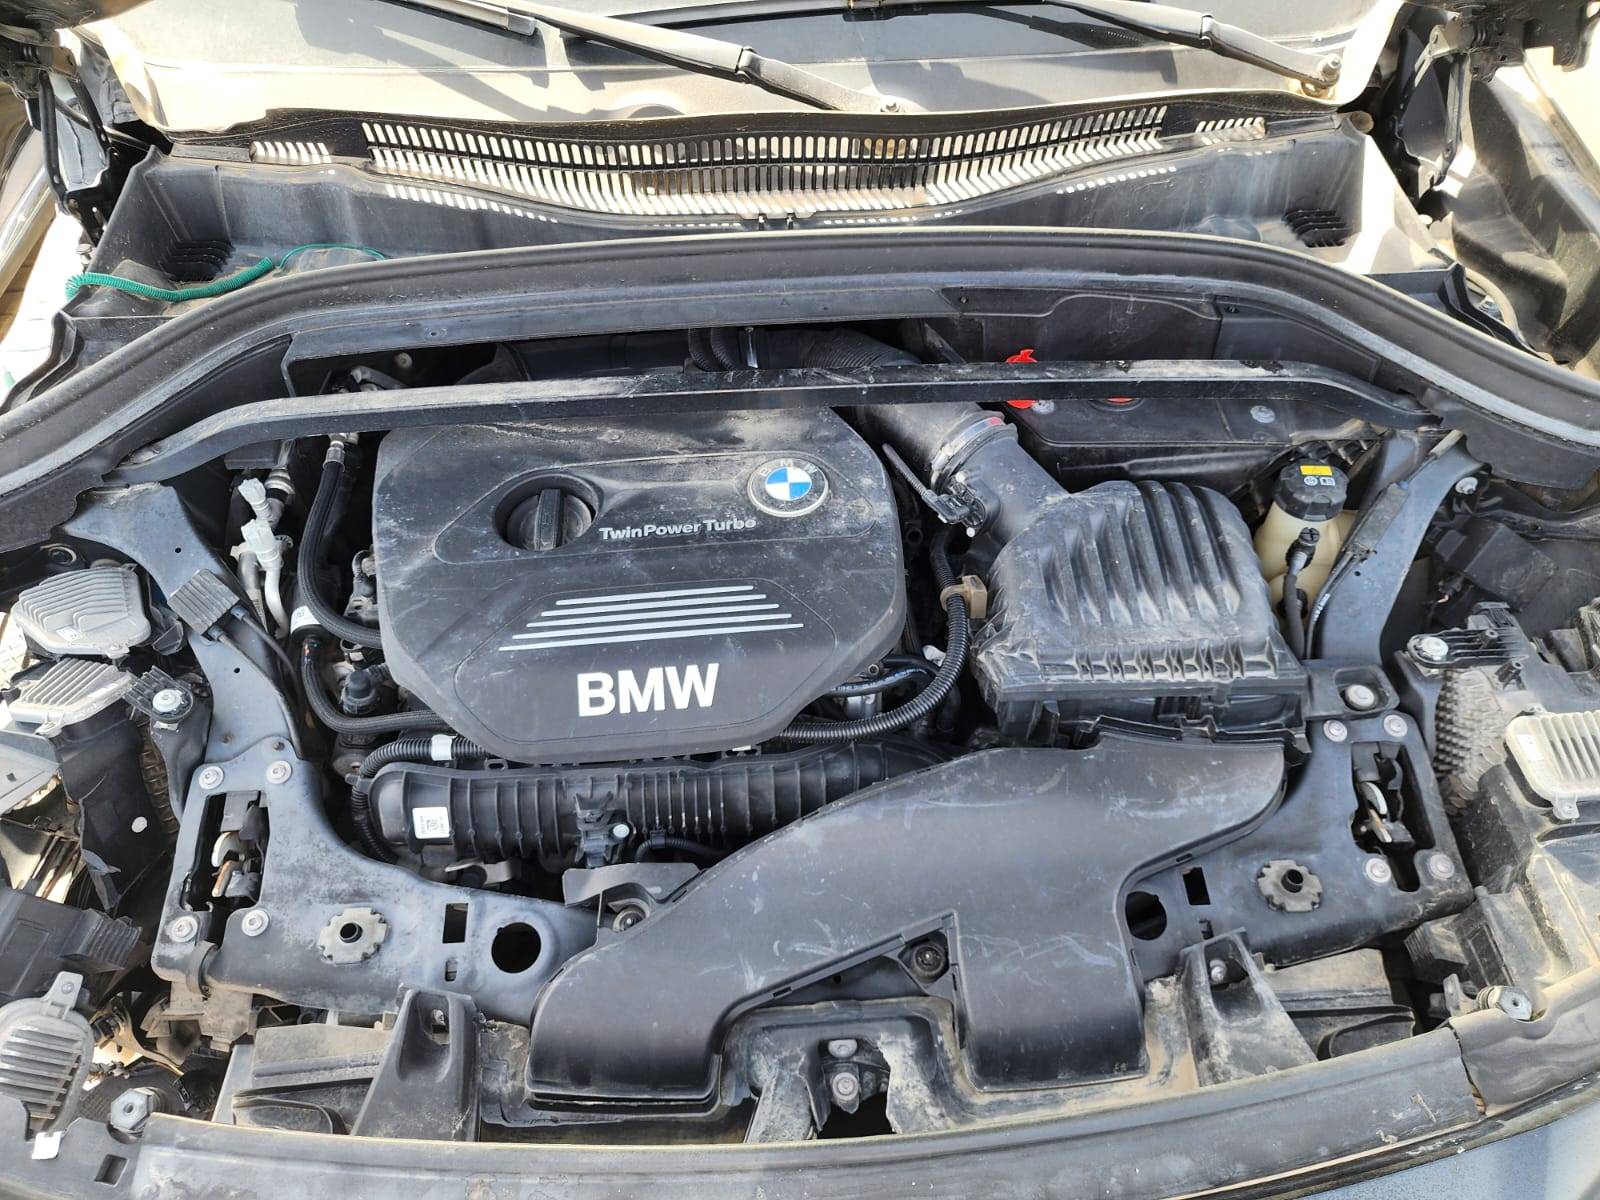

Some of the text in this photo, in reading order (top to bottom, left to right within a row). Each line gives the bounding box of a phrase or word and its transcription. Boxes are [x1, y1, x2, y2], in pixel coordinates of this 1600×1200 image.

[599, 518, 757, 539] TwinPower Turbo
[577, 662, 720, 717] BMW
